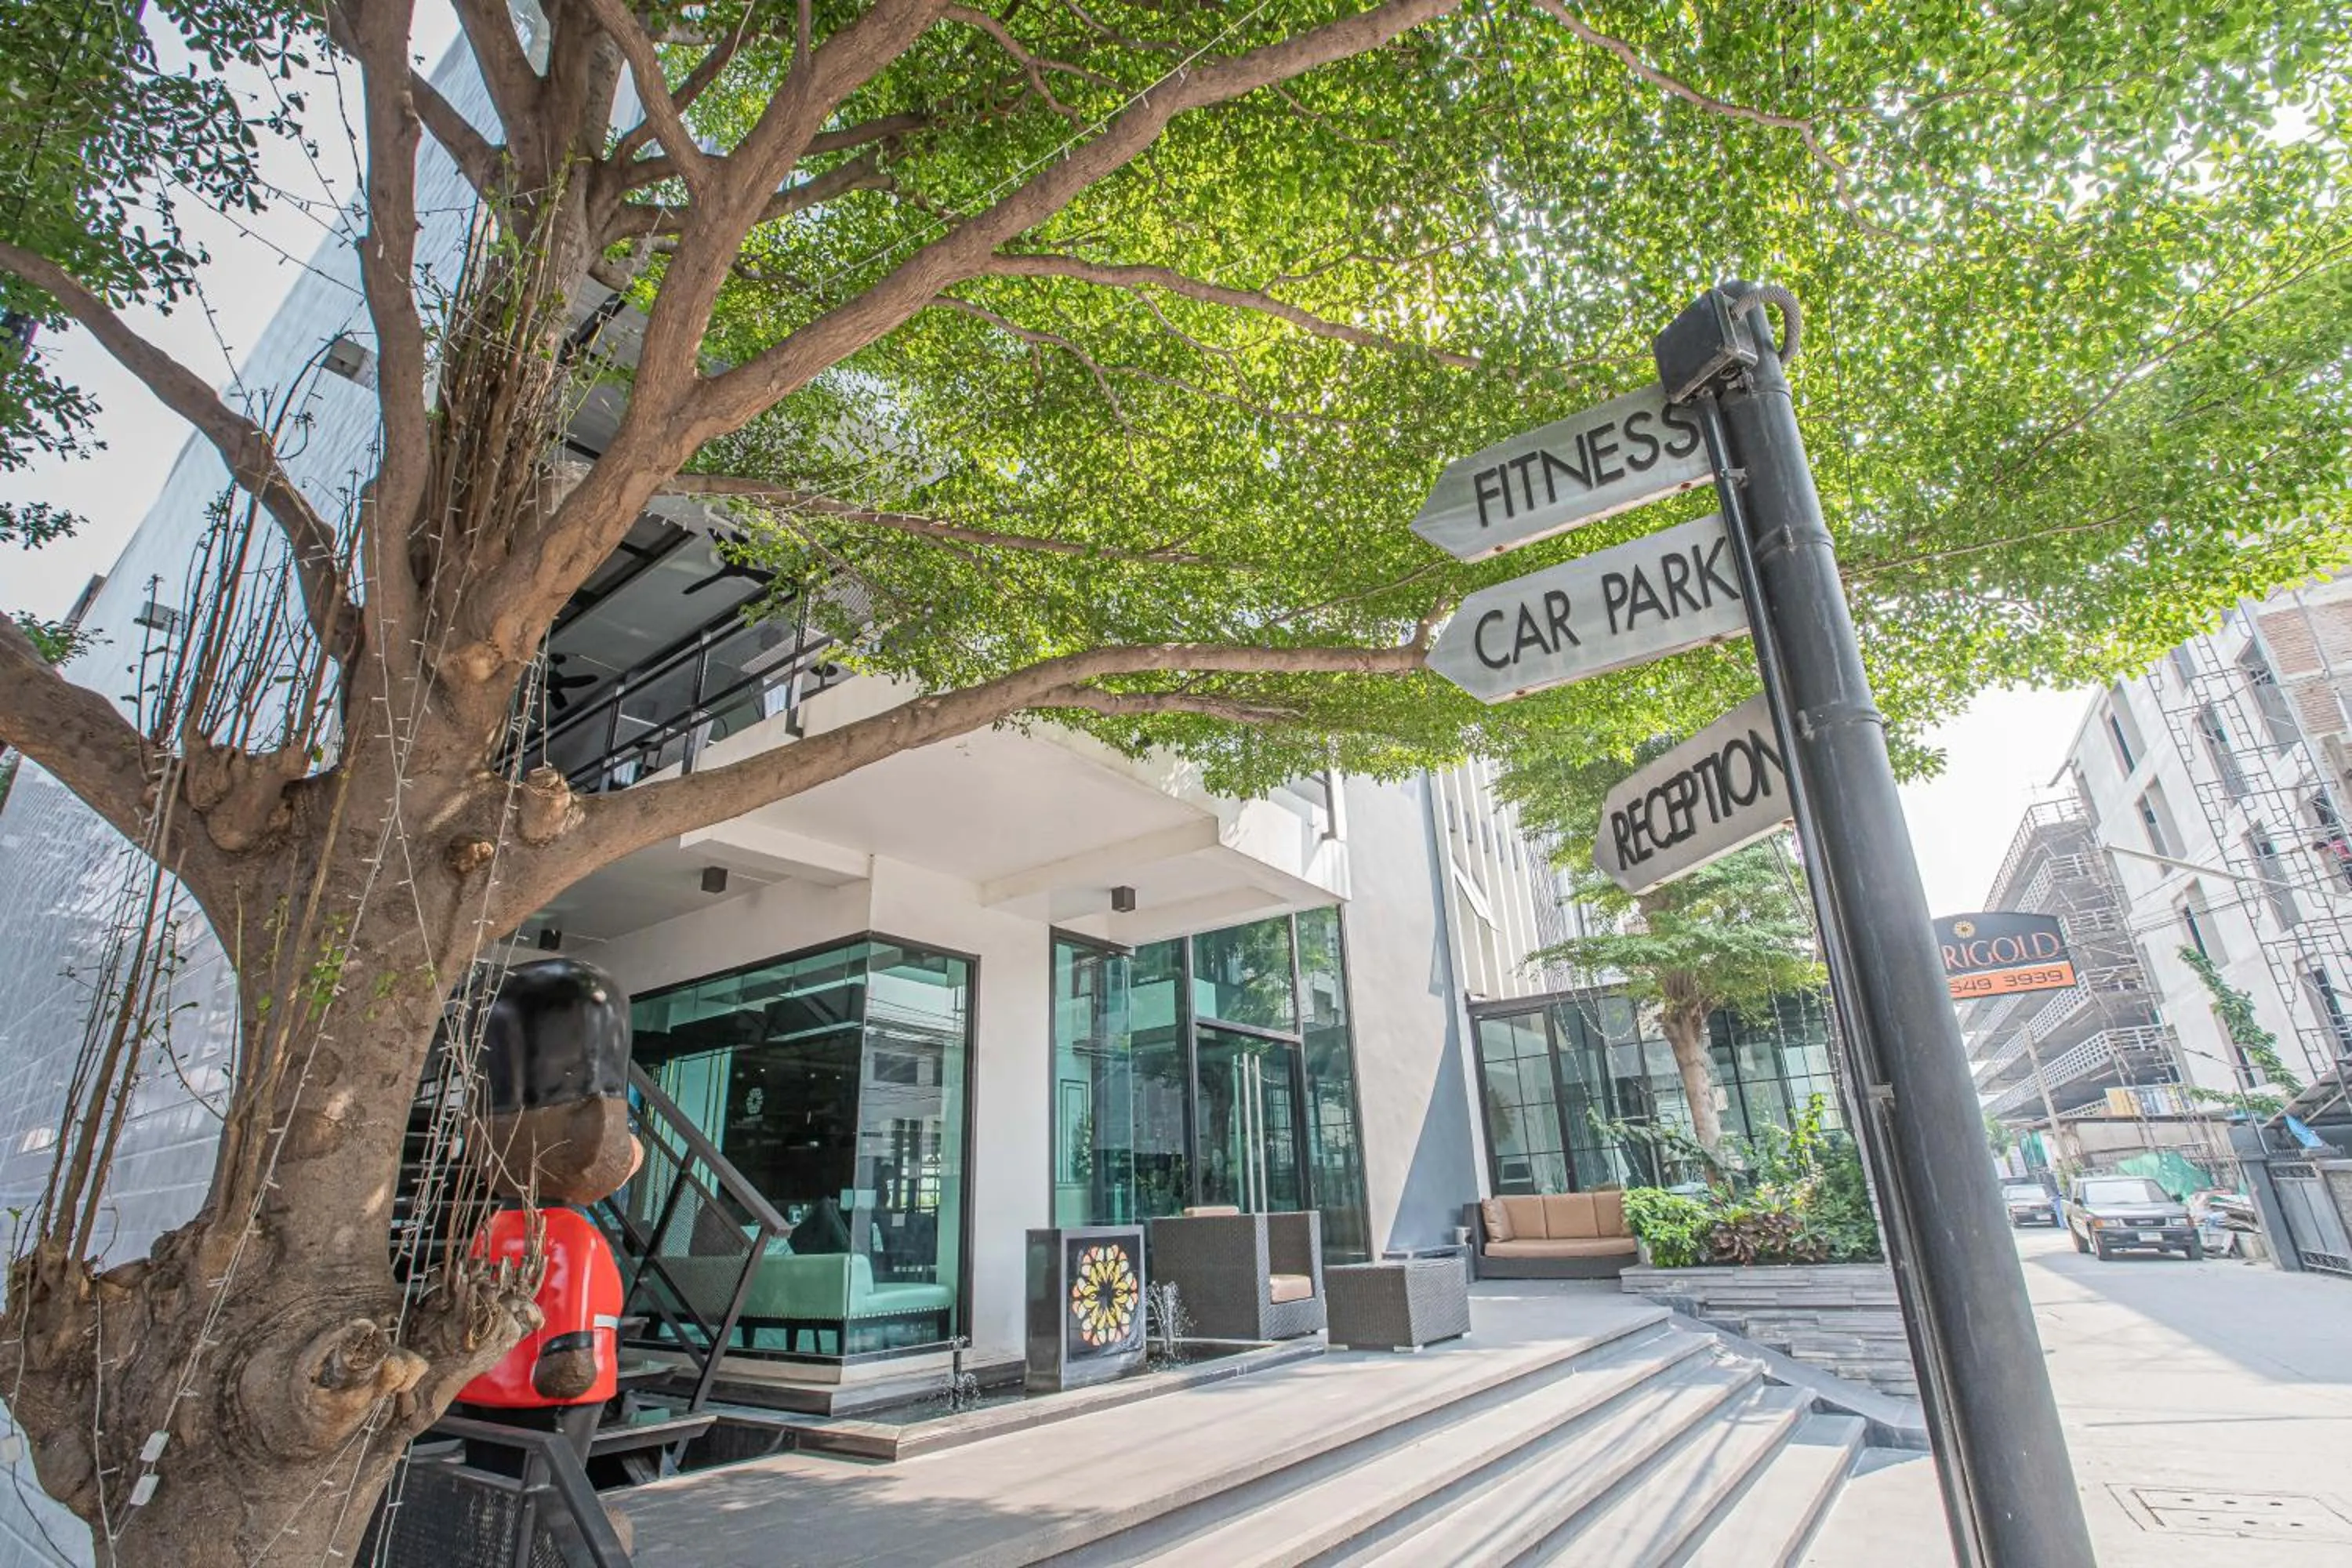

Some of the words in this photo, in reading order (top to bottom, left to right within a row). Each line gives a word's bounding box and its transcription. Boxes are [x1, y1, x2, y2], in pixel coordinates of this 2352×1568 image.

[1473, 401, 1700, 528] FITNESS
[1474, 590, 1581, 669] CAR
[1601, 535, 1741, 635] PARK
[1610, 728, 1784, 871] RECEPTION
[2003, 969, 2063, 987] 3939
